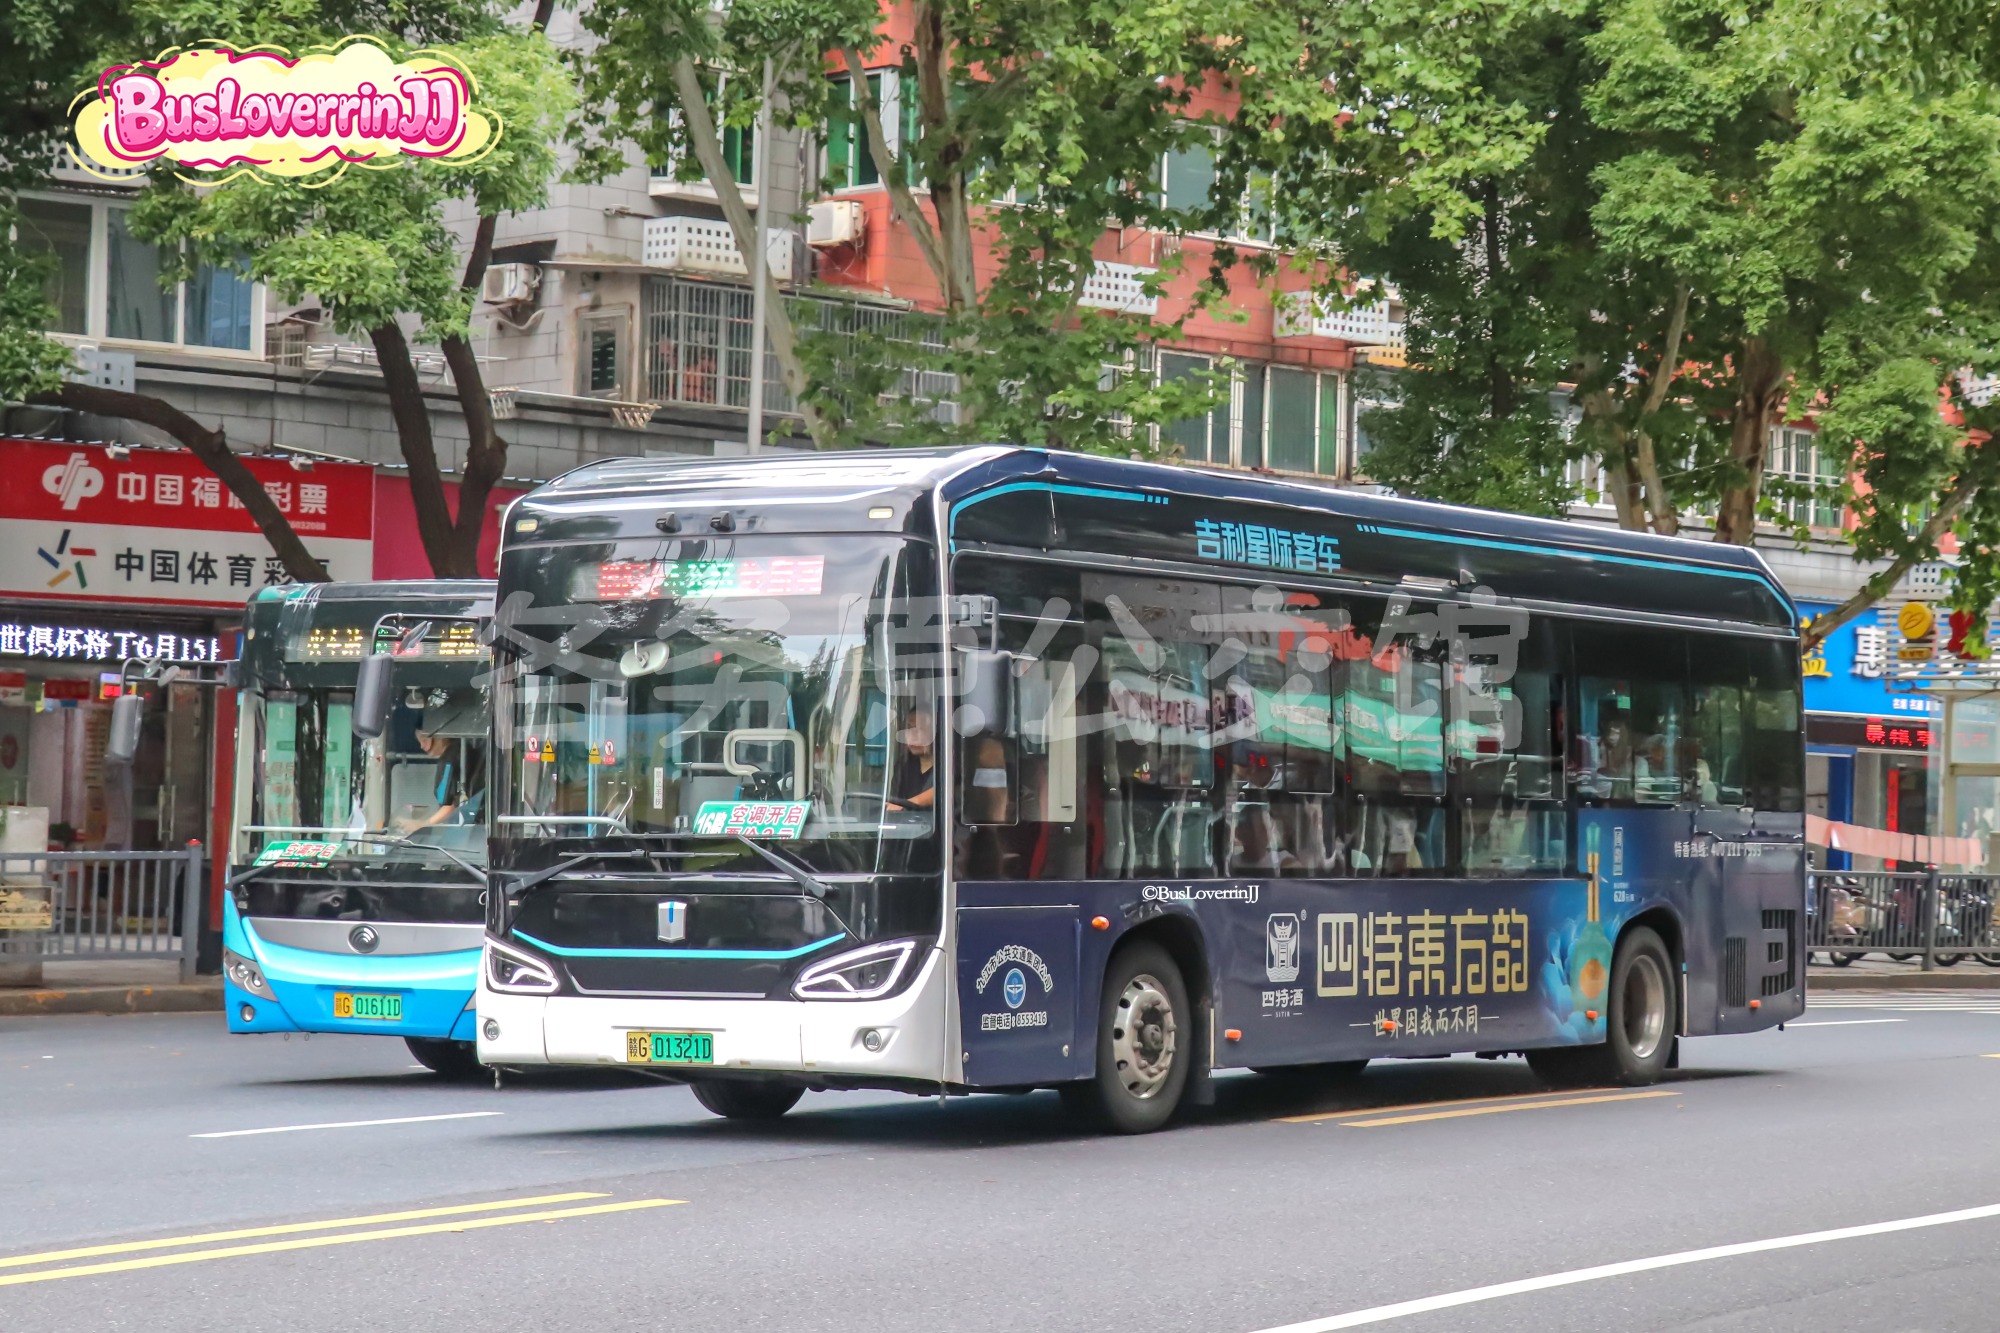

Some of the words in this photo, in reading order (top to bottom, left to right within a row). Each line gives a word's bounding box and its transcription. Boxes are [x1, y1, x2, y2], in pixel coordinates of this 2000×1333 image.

[1195, 519, 1341, 573] 吉利星际客车
[115, 548, 331, 587] 中国体育彩
[730, 805, 803, 825] 空调开启
[976, 945, 1054, 994] 九江市公共交通集团公司
[1262, 988, 1304, 1008] 四特酒
[1372, 1004, 1478, 1039] 世界因我而不同
